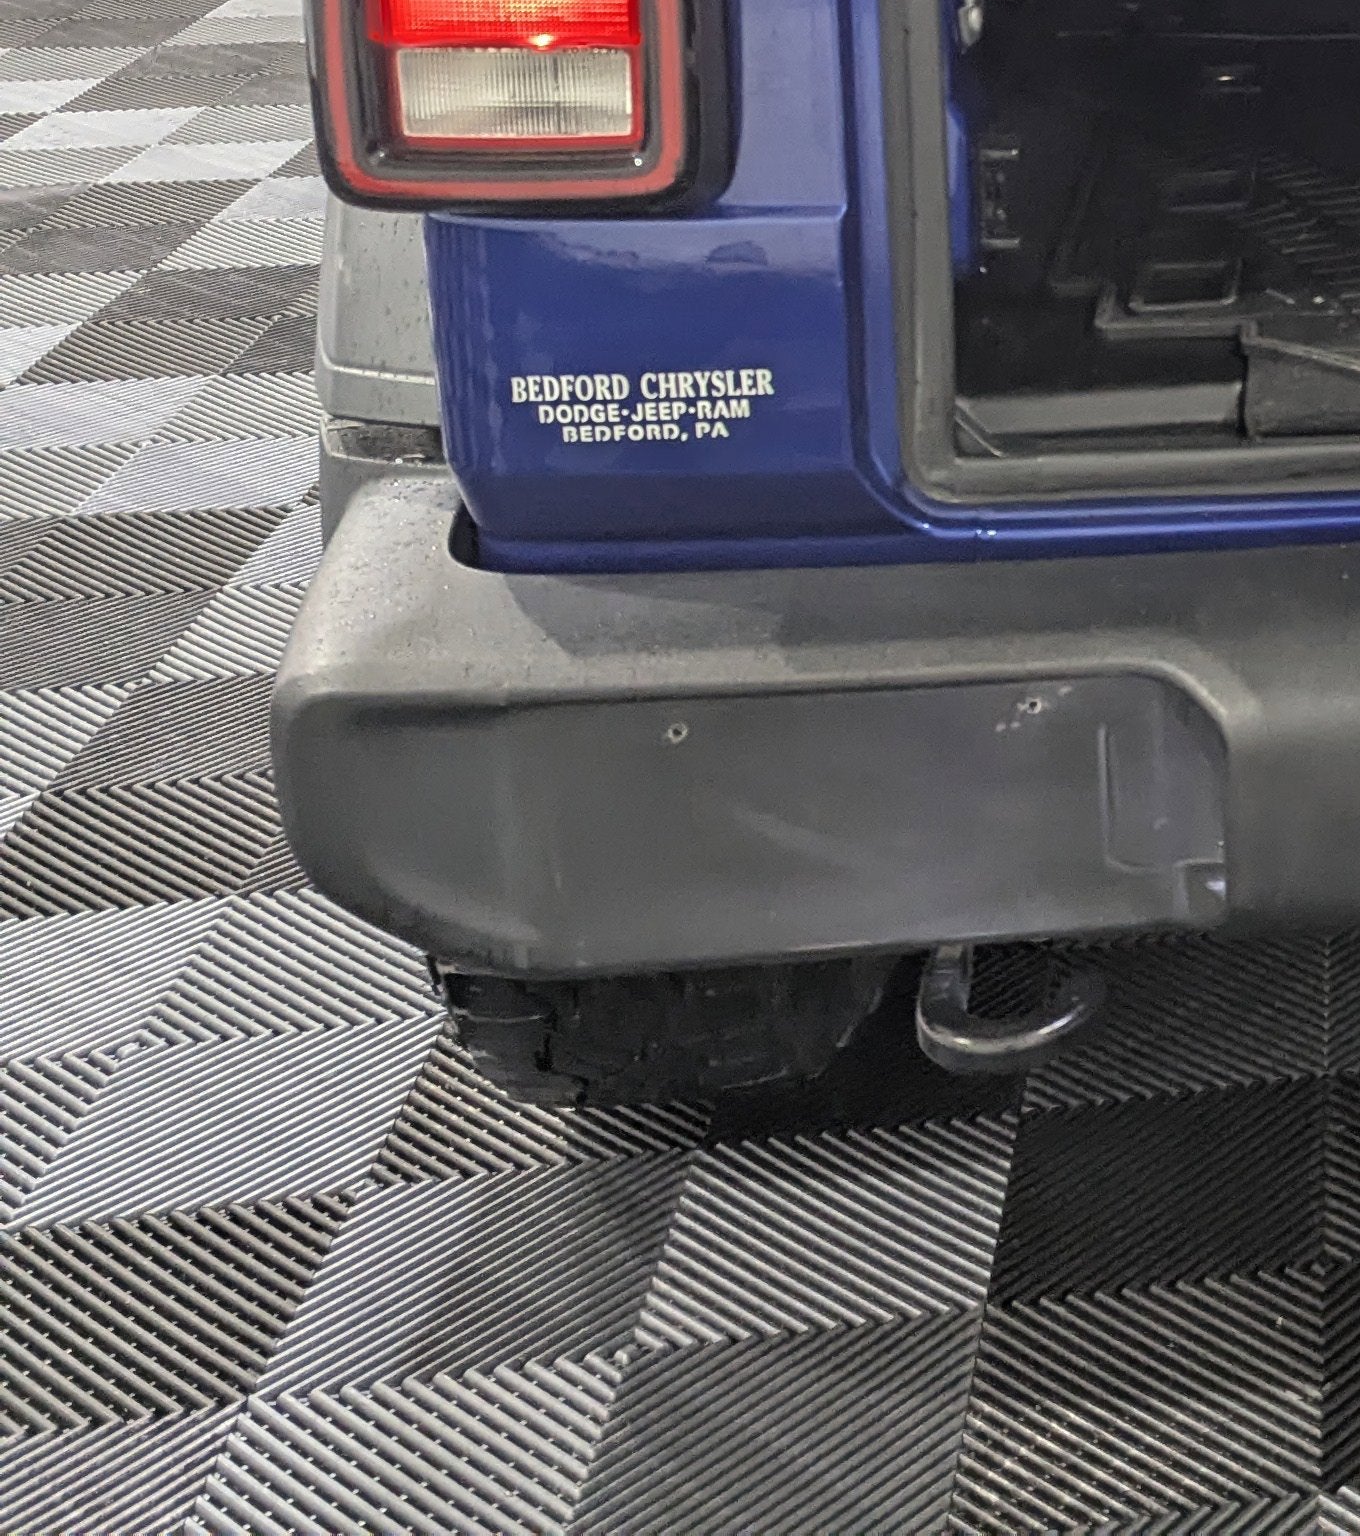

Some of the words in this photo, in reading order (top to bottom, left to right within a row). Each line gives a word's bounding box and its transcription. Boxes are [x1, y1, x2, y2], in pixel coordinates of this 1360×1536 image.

[510, 373, 630, 403] BEDFORD
[640, 368, 775, 400] CHRYSLER
[562, 424, 689, 443] BEDFORD,
[695, 421, 730, 438] PA
